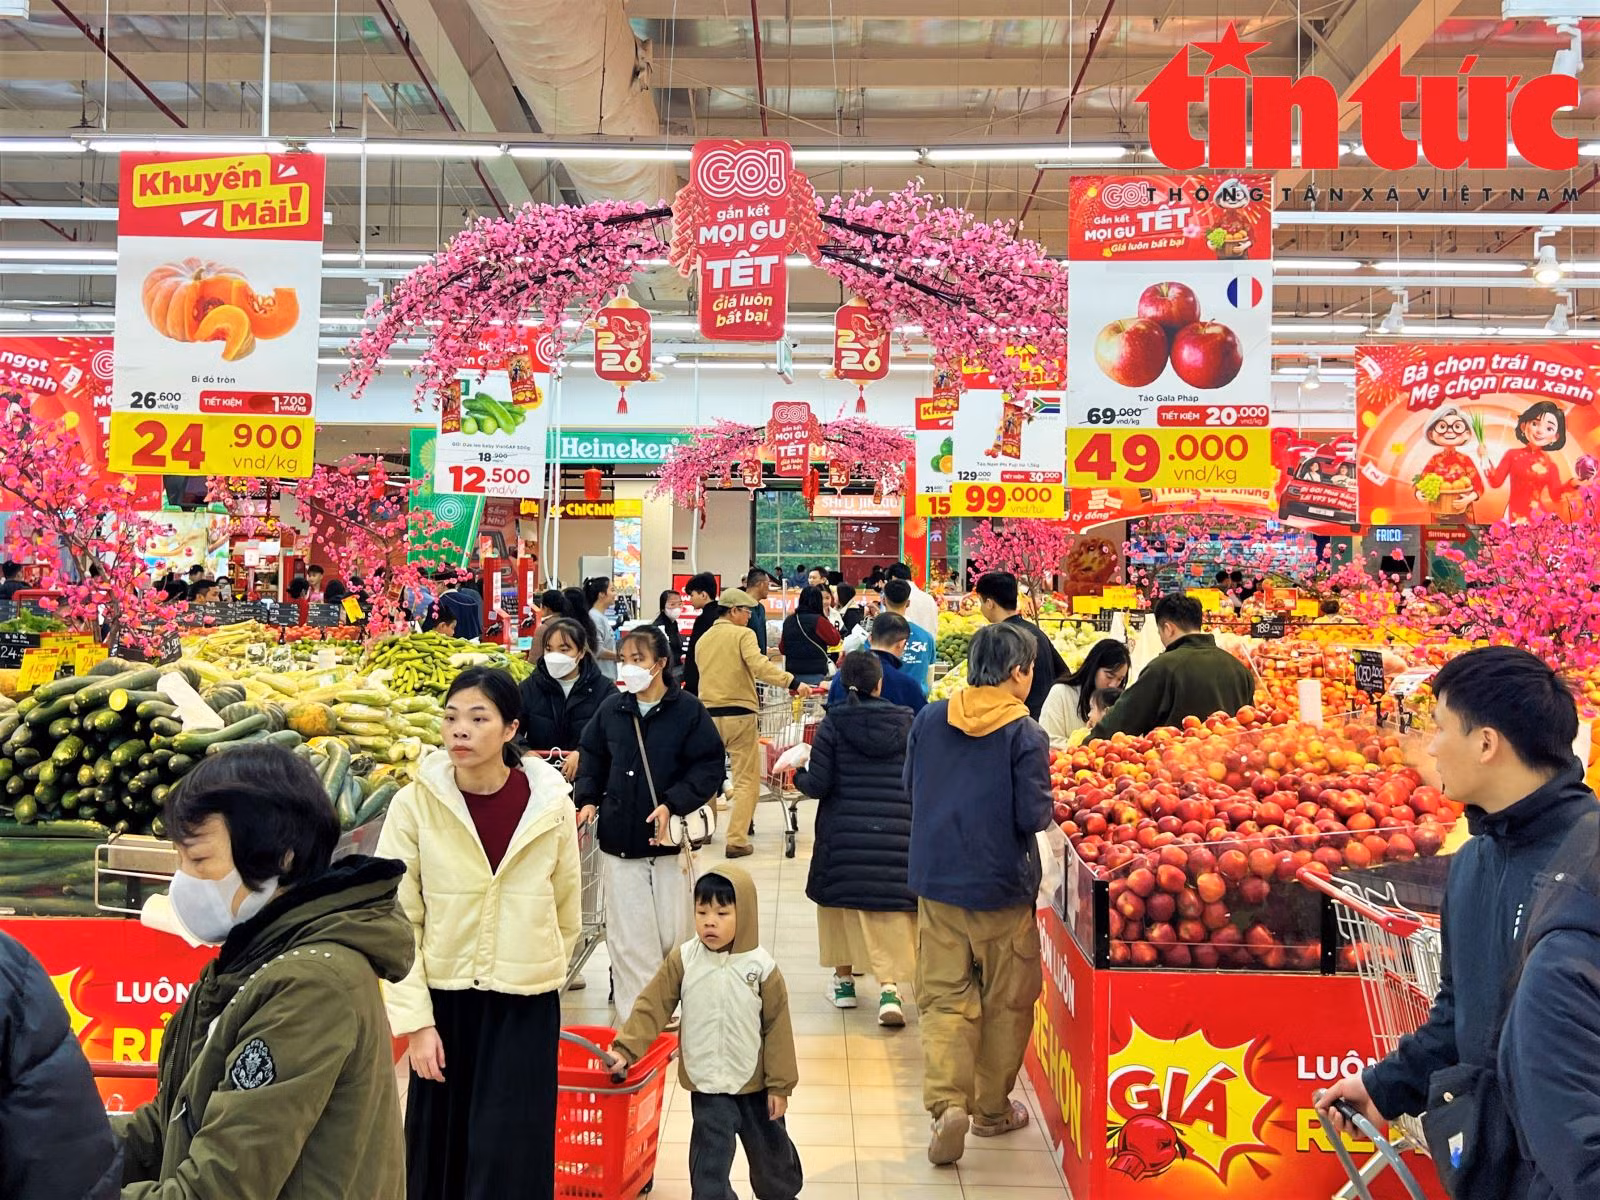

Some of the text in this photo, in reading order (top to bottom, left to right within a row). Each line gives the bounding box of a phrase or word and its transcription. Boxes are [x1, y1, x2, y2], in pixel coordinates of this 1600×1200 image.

[138, 160, 262, 197] Khuyến
[698, 149, 786, 198] GO!
[1101, 181, 1150, 209] GO!
[229, 186, 303, 226] Mãi!
[747, 203, 770, 217] kết
[1114, 213, 1130, 223] kết
[1136, 200, 1191, 233] TẾT
[699, 219, 787, 247] MỌI GU
[1084, 226, 1136, 243] MỌI GU
[1111, 237, 1185, 253] Giá luôn bất bại
[706, 243, 780, 289] TẾT
[712, 292, 773, 312] Giá luôn
[715, 308, 769, 328] bất bại
[0, 351, 49, 372] ngọt
[1434, 355, 1485, 377] chọn
[1491, 353, 1529, 370] trái
[1532, 359, 1584, 381] ngọt
[10, 370, 58, 393] xanh
[1409, 374, 1594, 407] Mẹ chọn rau xanh
[203, 396, 242, 407] TIẾT KIỆM
[1138, 394, 1199, 403] Táo Gala Pháp
[280, 405, 307, 413] vnd/kg
[774, 404, 808, 423] GO!
[1161, 411, 1200, 421] TIẾT KIỆM
[1116, 418, 1140, 426] vnd/kg
[775, 430, 809, 442] MỌI GU
[561, 437, 674, 459] Heineken
[777, 440, 806, 457] TẾT
[233, 455, 298, 472] vnd/kg
[1174, 464, 1237, 484] vnd/kg
[1376, 528, 1401, 542] FRICO
[1427, 531, 1450, 539] Sitting
[1049, 1022, 1083, 1160] HƠN
[1107, 1061, 1238, 1140] GIÁ
